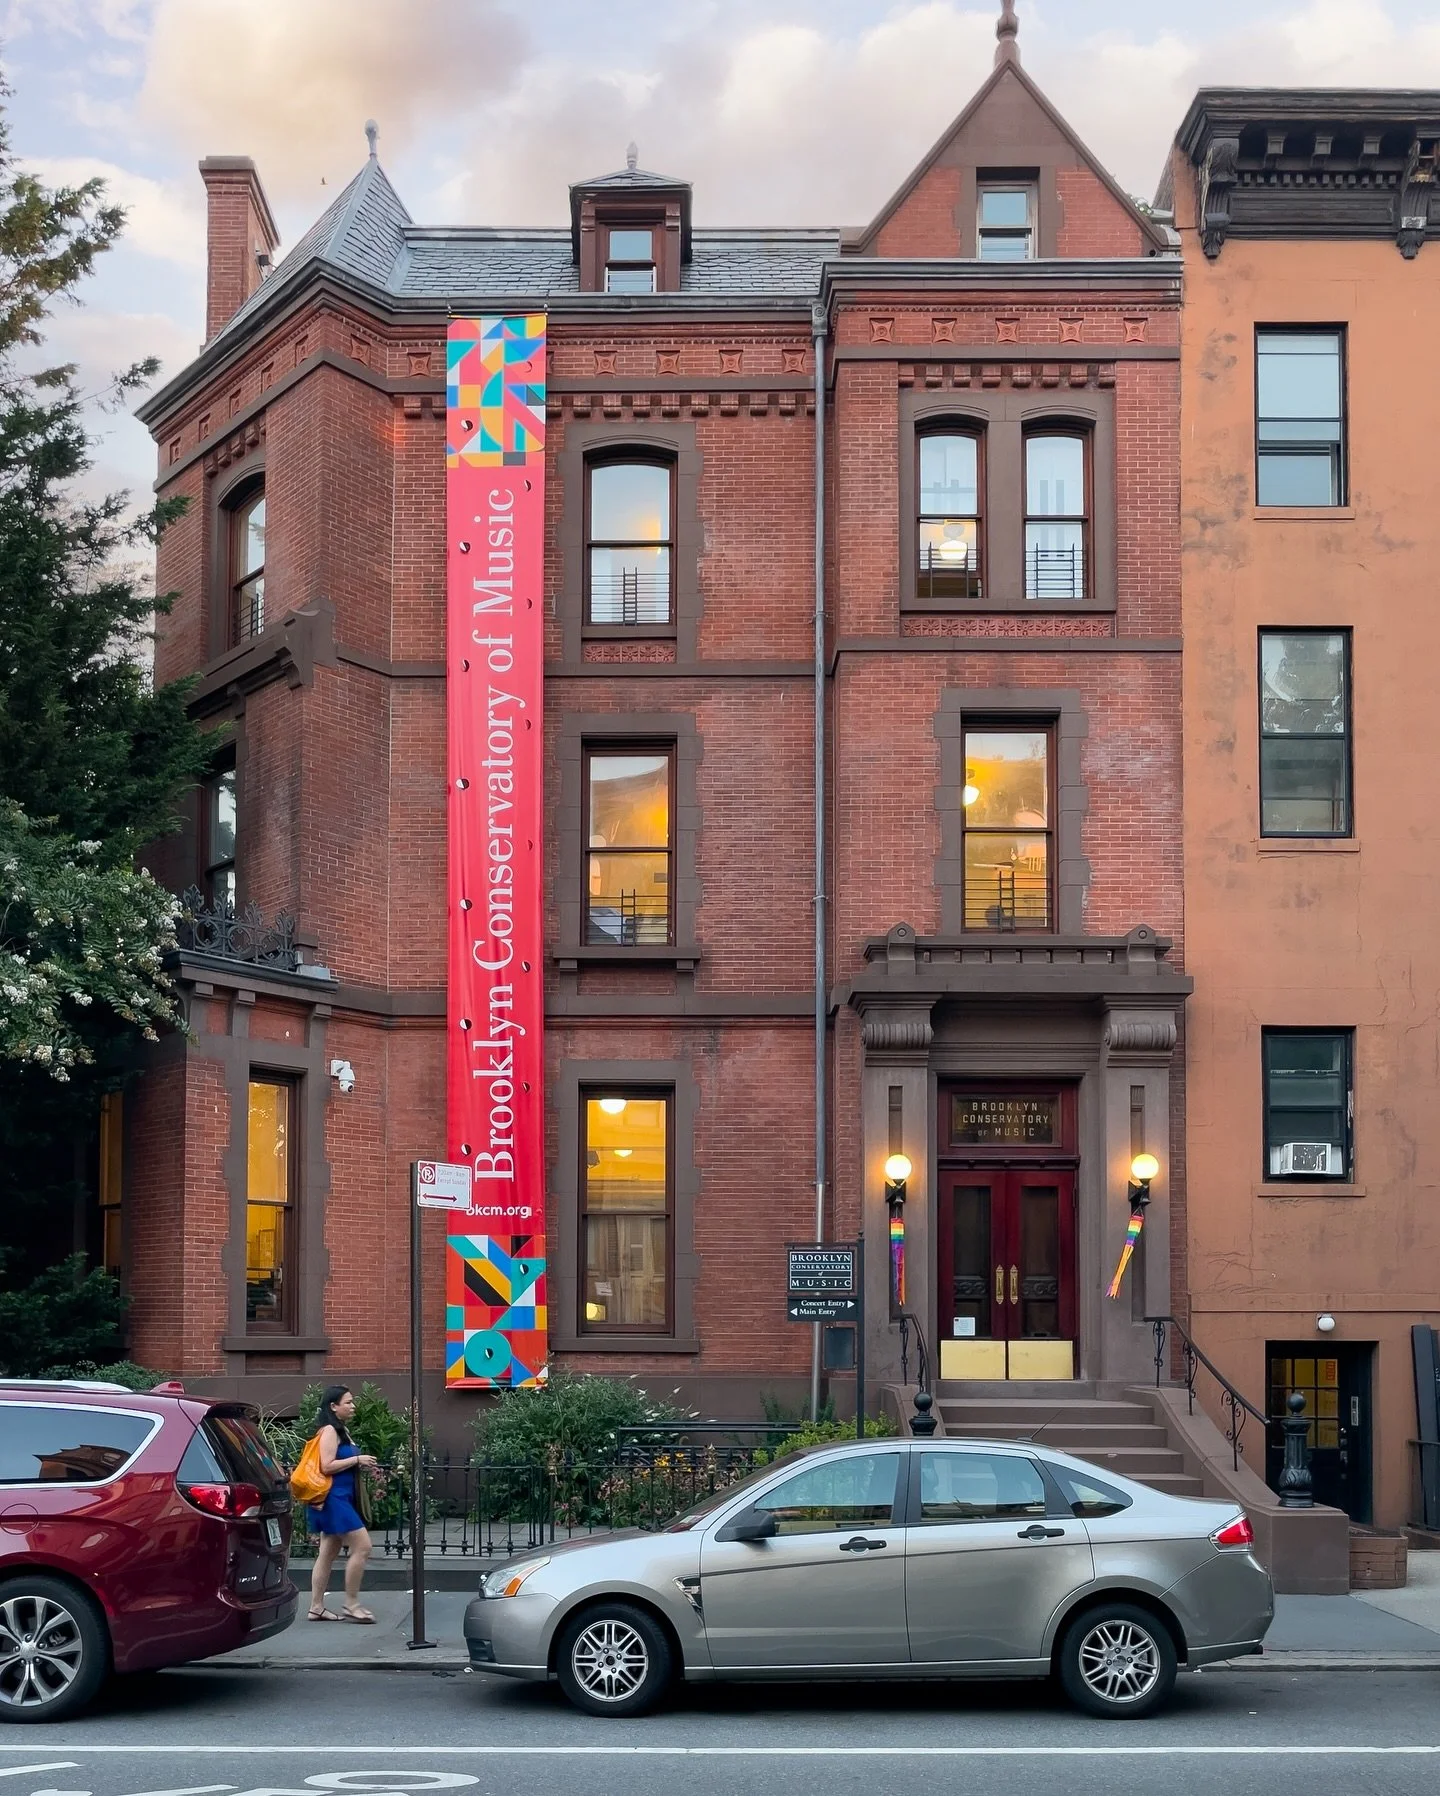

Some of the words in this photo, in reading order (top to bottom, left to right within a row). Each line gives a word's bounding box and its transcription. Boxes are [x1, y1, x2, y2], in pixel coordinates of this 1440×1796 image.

[473, 488, 515, 616] Music
[472, 629, 515, 673] of
[473, 685, 526, 971] Conservatory
[473, 983, 526, 1182] Brooklyn
[972, 1102, 1038, 1111] BROOKLYN
[962, 1114, 1049, 1123] CONSERVATORY
[995, 1128, 1035, 1136] MUSIC
[791, 1254, 851, 1262] BROOKLYN
[827, 1300, 846, 1308] Entry
[818, 1308, 836, 1316] Entry
